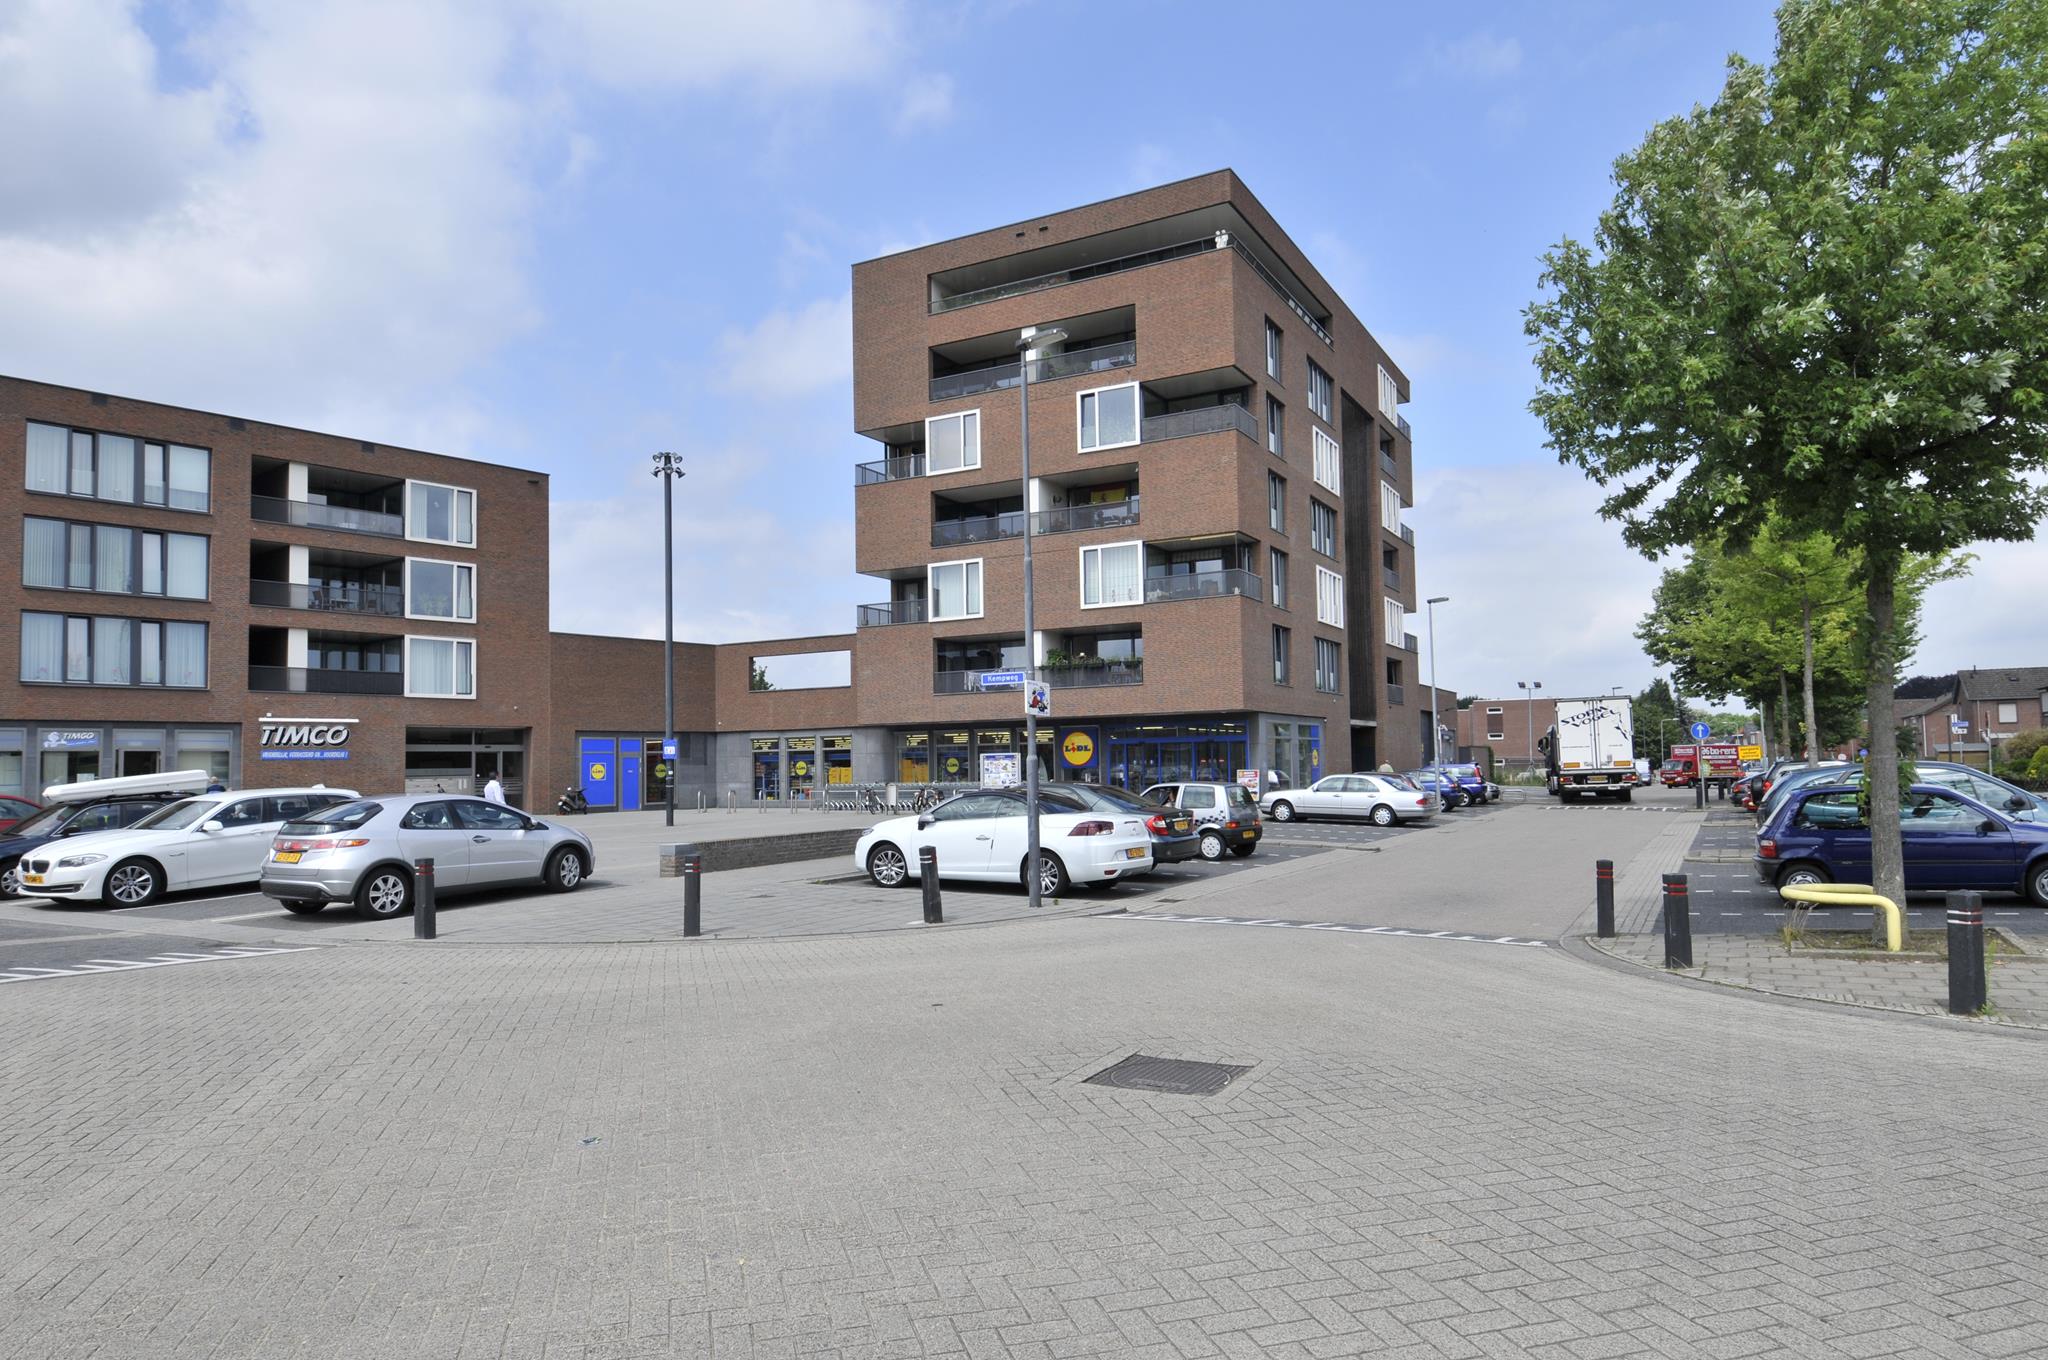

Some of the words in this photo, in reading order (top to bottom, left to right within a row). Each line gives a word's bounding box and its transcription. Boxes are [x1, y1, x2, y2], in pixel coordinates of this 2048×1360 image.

[1561, 706, 1609, 726] STORM
[1571, 710, 1618, 728] VOGEL
[261, 726, 350, 746] TIMCO
